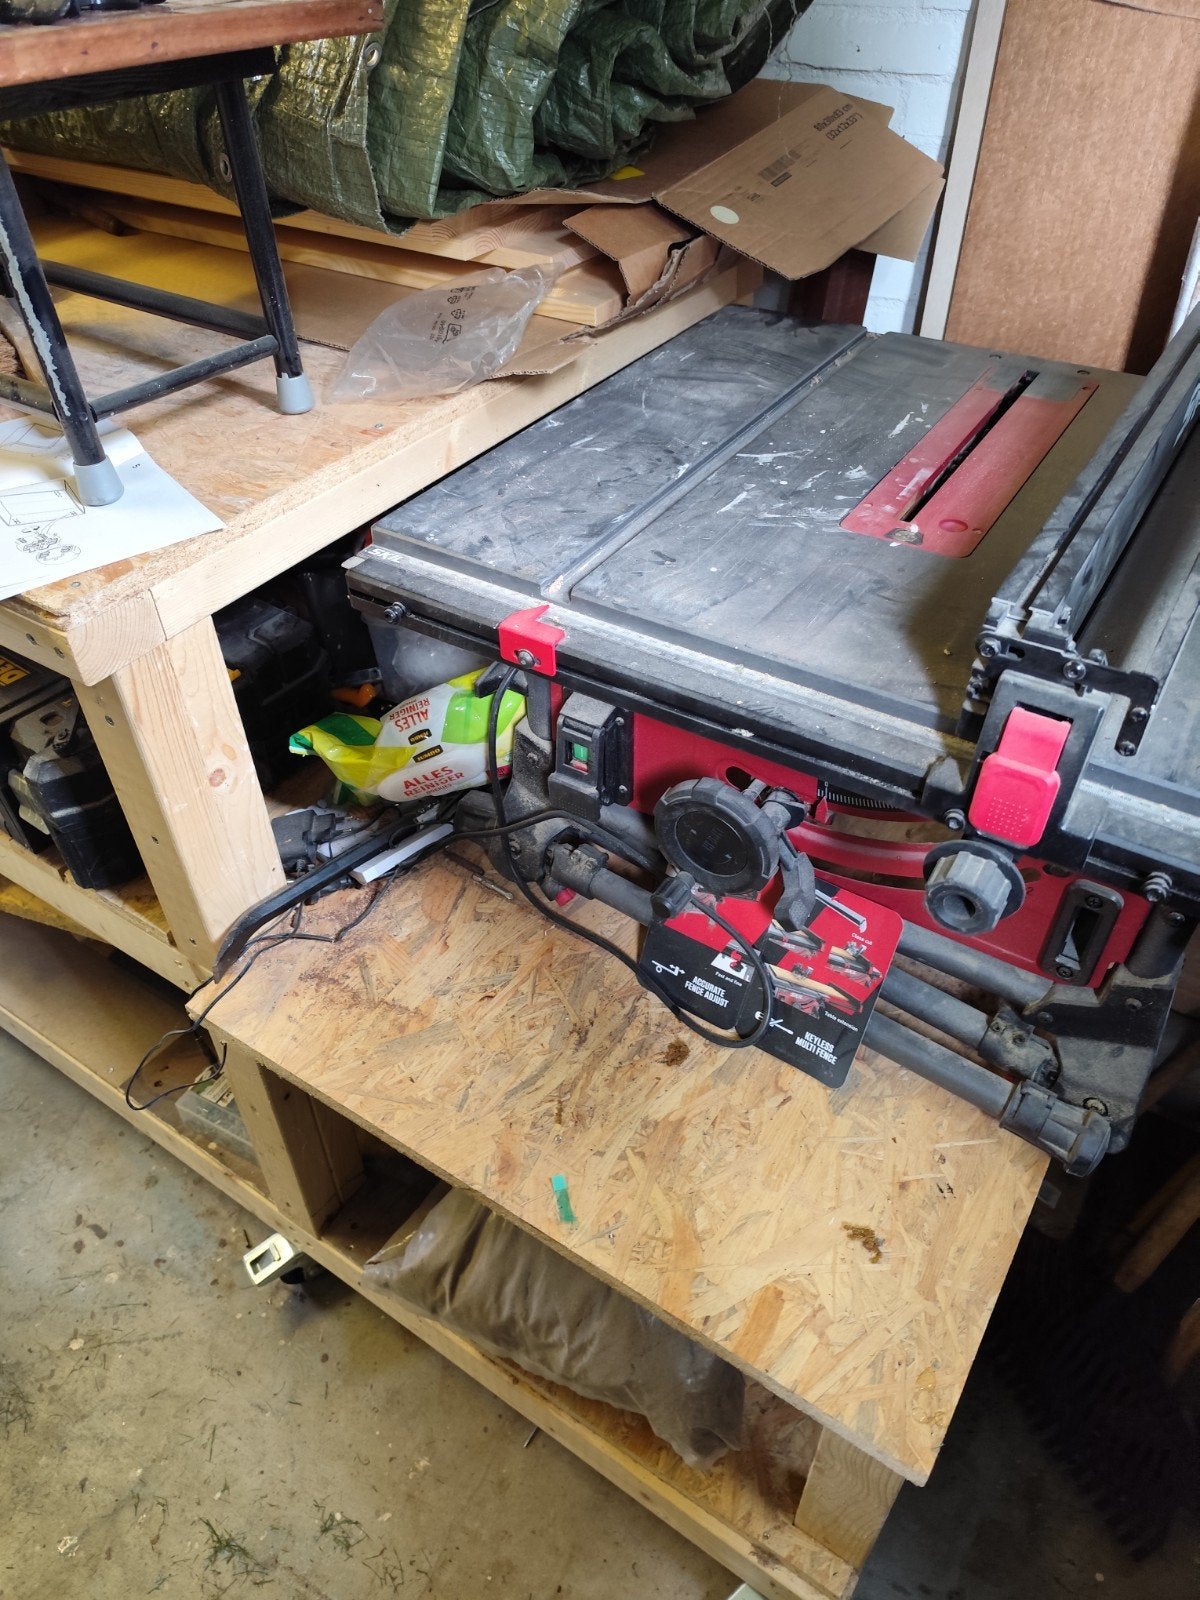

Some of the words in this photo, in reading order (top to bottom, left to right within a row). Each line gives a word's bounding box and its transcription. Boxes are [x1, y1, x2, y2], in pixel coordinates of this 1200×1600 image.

[389, 697, 431, 721] REINIGER
[394, 708, 429, 733] ALLES
[403, 765, 454, 789] ALLES
[403, 771, 465, 797] REINIGER
[851, 932, 865, 942] Close
[692, 975, 726, 998] ACCURATE
[724, 975, 735, 983] and
[684, 980, 705, 997] FENCE
[703, 990, 730, 1008] ADJUST
[824, 1010, 837, 1021] Table
[836, 1018, 859, 1032] extension
[795, 1036, 817, 1054] MULTI
[815, 1047, 838, 1066] FENCE
[804, 1031, 835, 1054] KEYLESS
